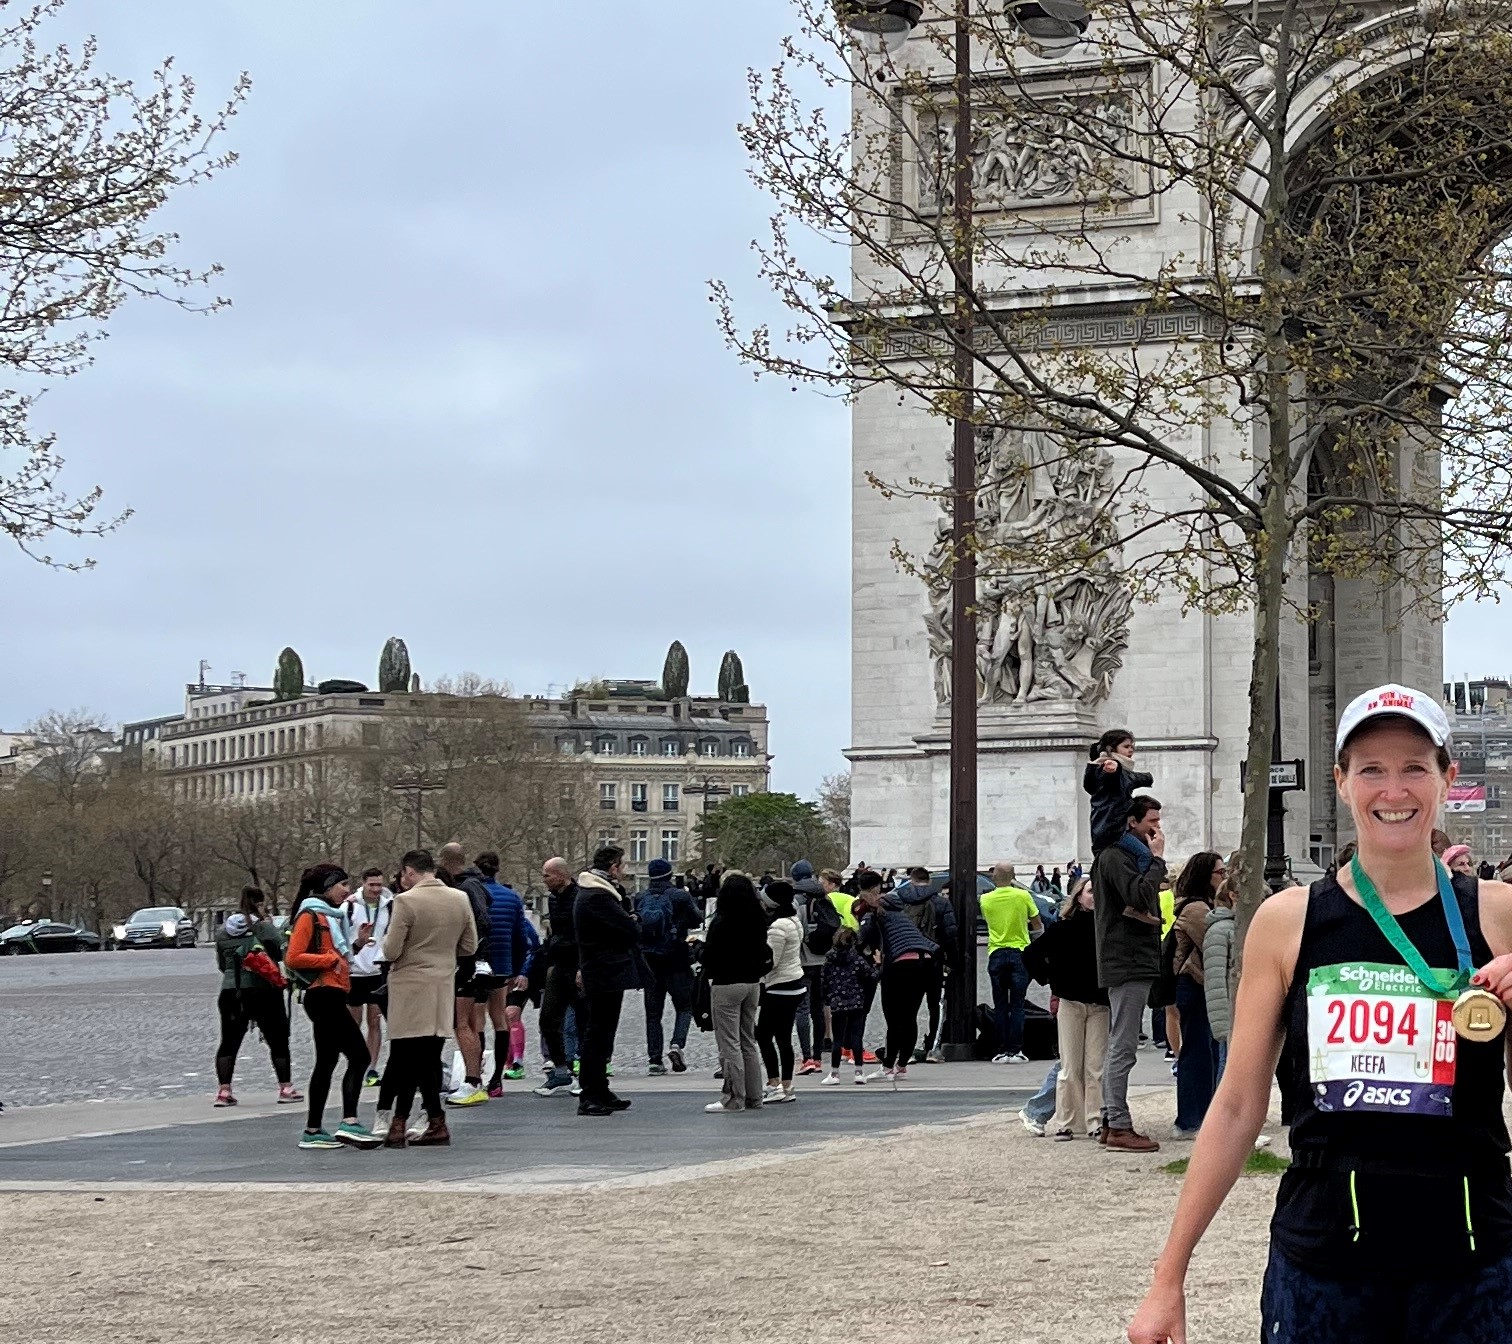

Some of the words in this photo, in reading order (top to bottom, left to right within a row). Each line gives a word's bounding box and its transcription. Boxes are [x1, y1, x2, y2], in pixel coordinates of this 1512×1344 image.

[1327, 1000, 1418, 1045] 2094
[1435, 1041, 1455, 1063] 00
[1350, 1054, 1386, 1075] KEEFA
